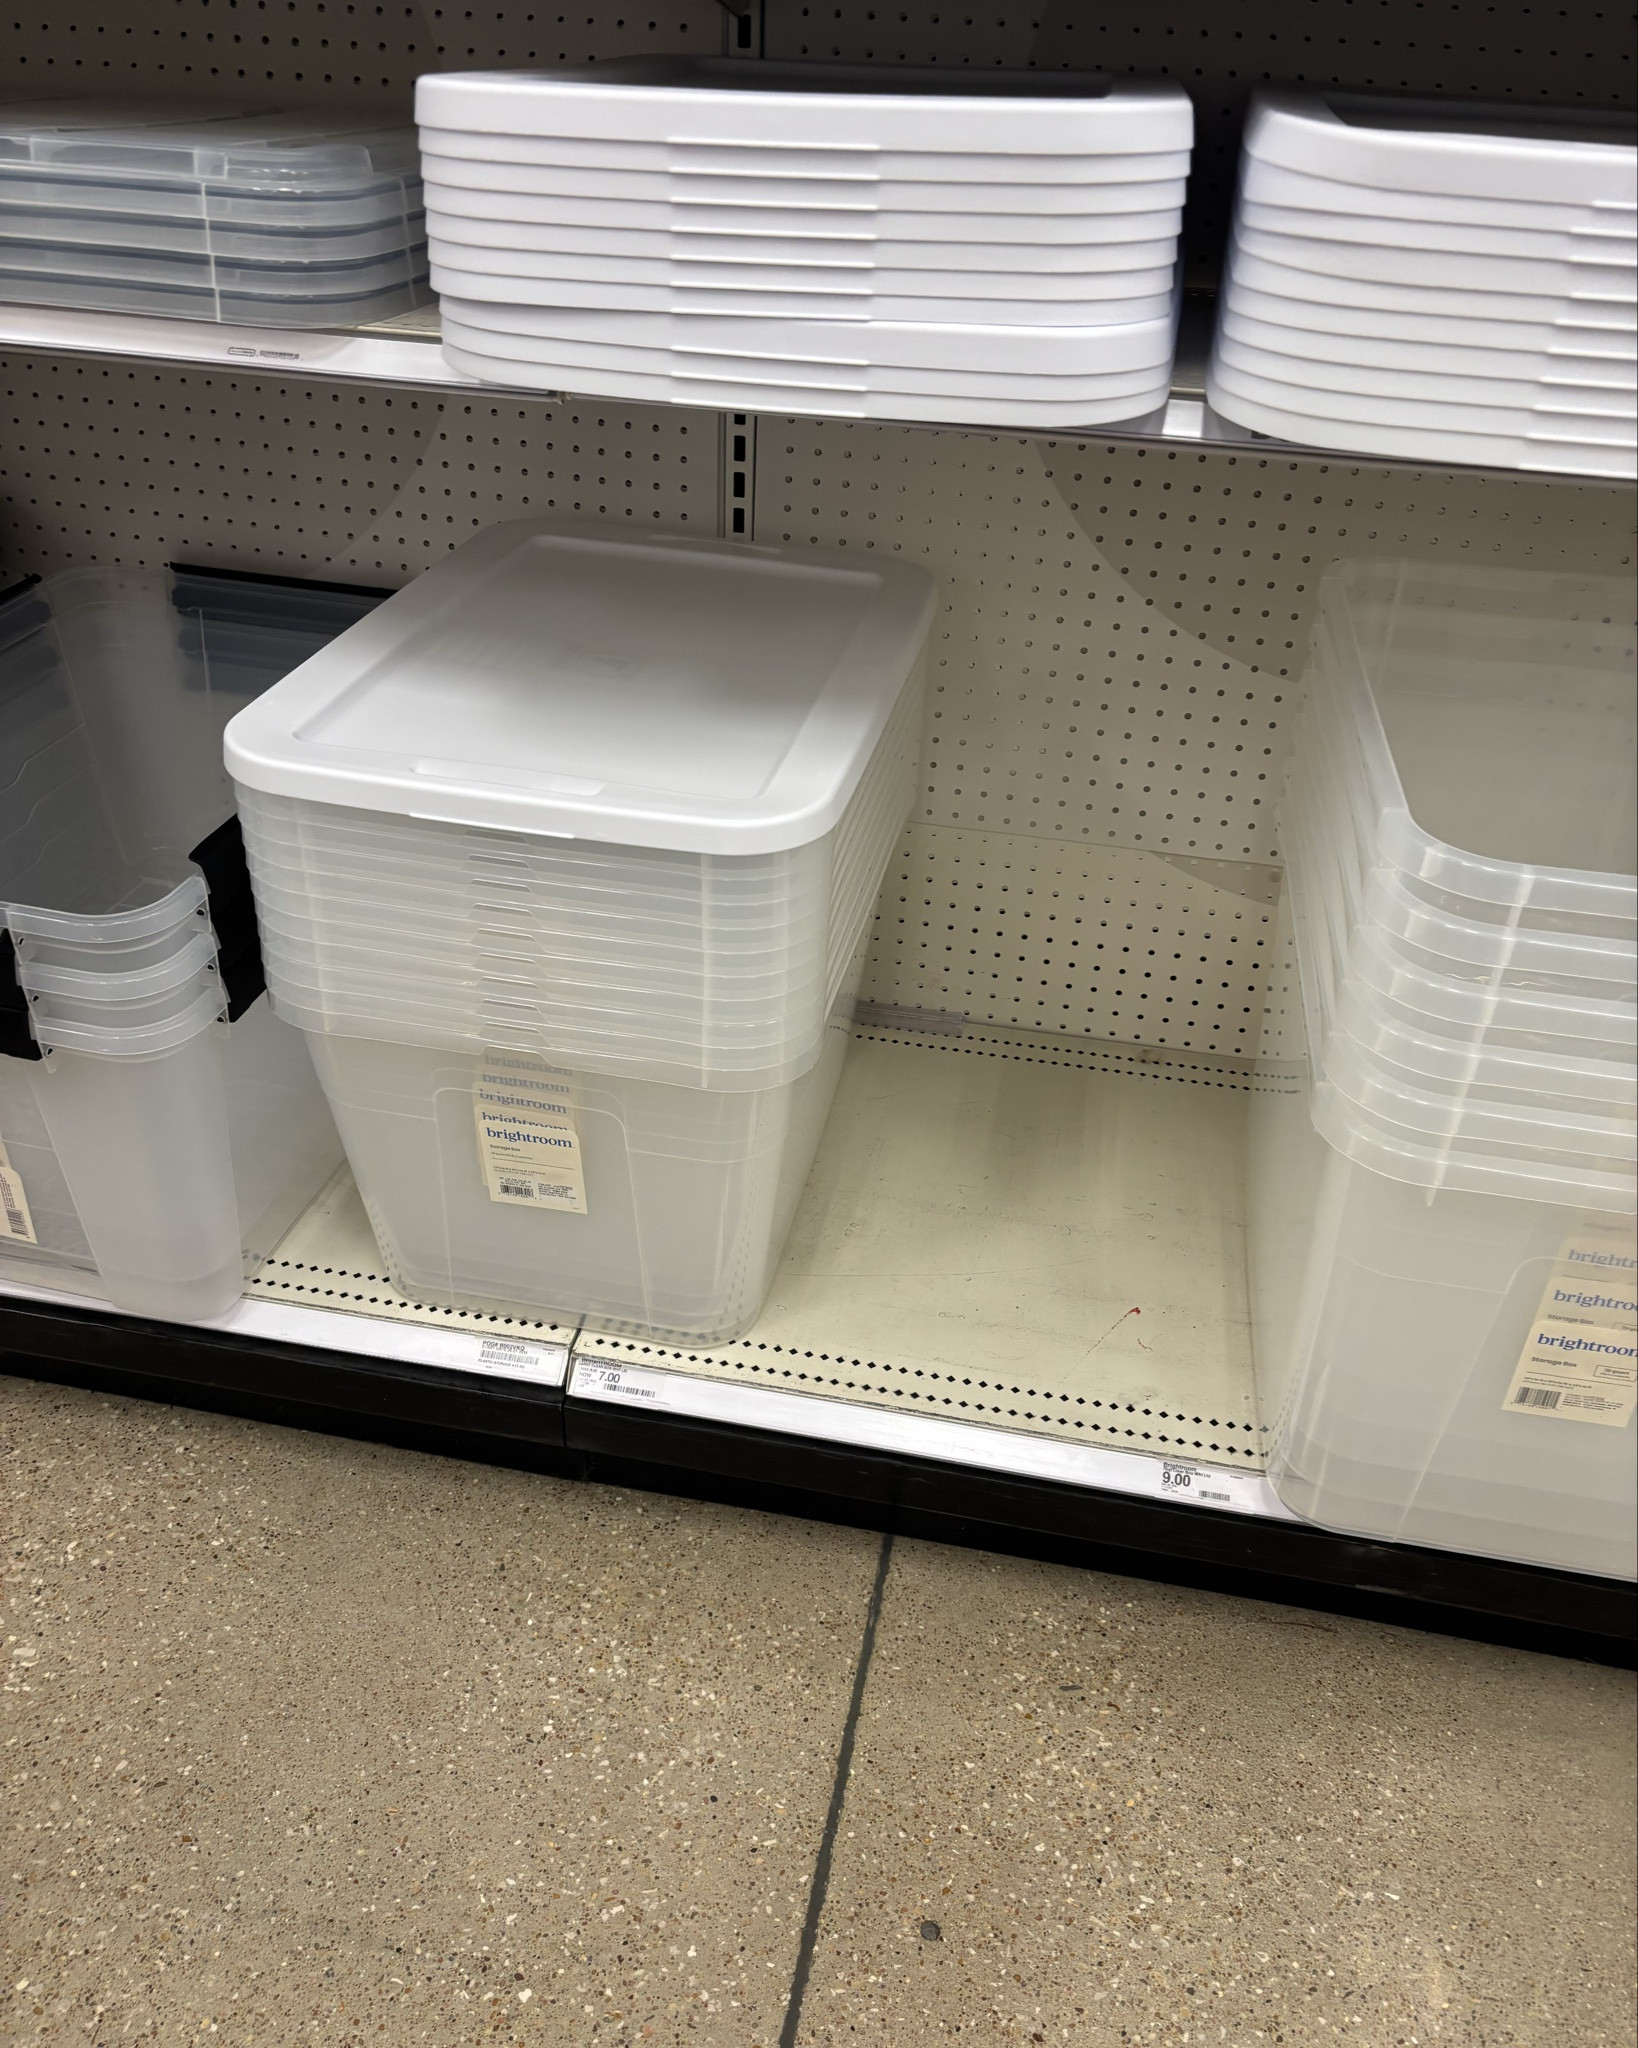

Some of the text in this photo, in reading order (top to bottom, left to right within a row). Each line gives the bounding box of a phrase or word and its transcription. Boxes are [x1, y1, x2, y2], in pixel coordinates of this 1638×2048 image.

[486, 1127, 573, 1148] brightroom
[1531, 1357, 1562, 1365] Storage
[599, 1371, 620, 1383] 7.00
[1162, 1471, 1191, 1487] 9.00
